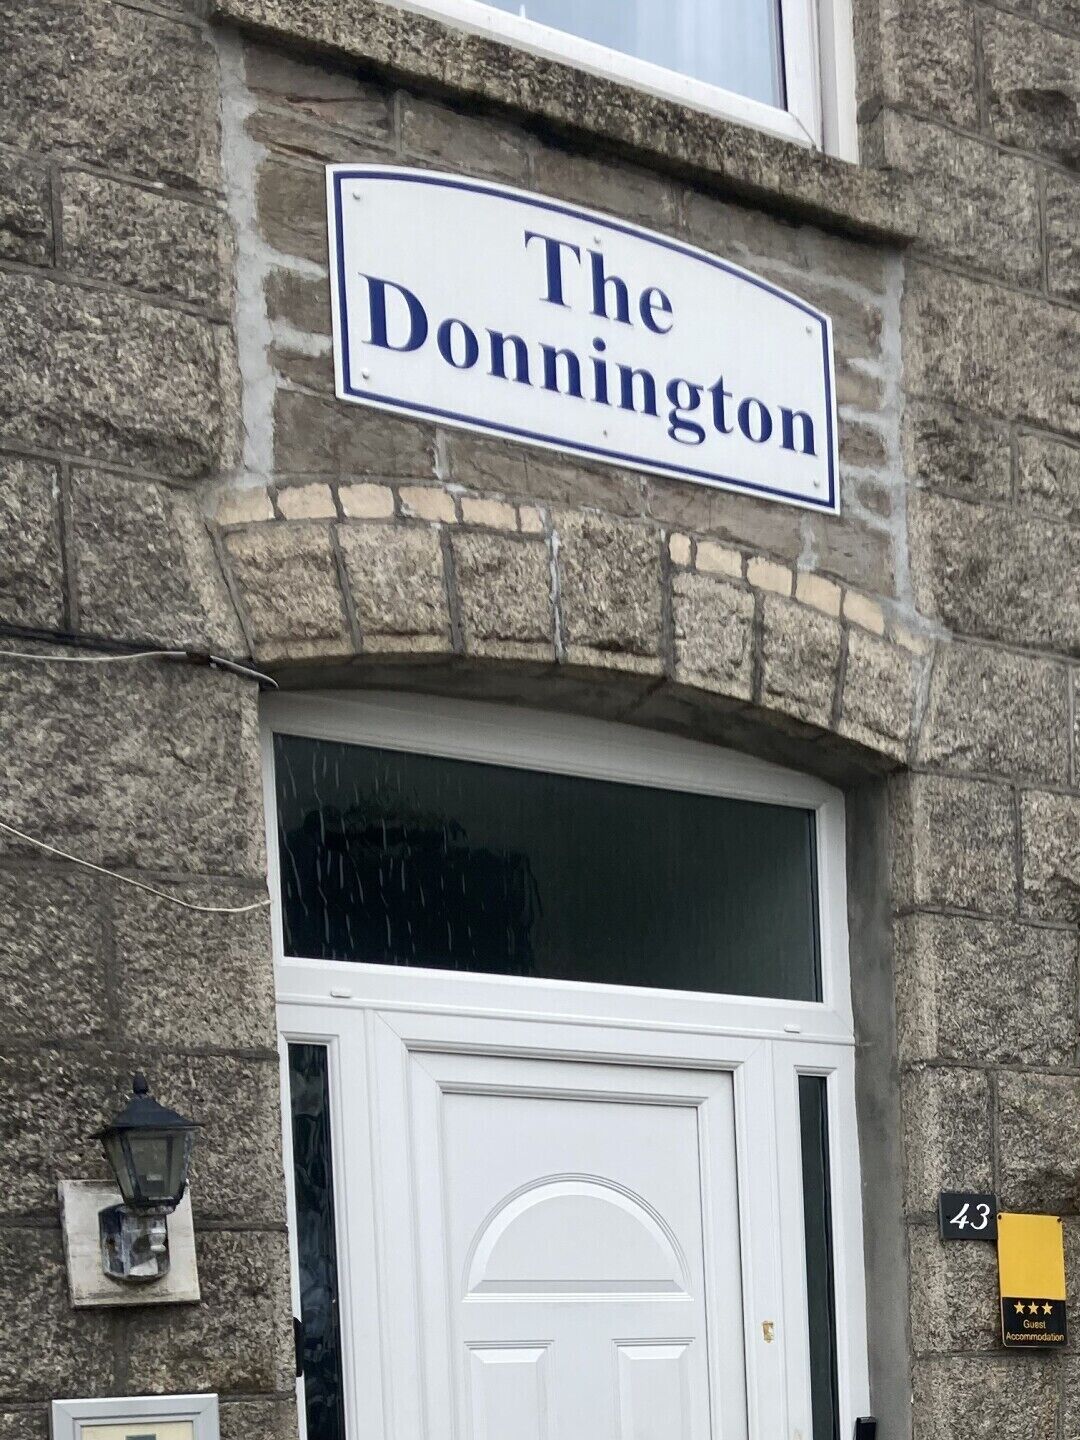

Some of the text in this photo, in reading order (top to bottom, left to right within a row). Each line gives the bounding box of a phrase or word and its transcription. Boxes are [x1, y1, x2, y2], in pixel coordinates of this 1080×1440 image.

[524, 230, 674, 335] The
[357, 271, 818, 458] Donnington
[949, 1203, 991, 1230] 43
[1005, 1332, 1064, 1342] Accommodation
[1023, 1319, 1046, 1329] Guest
